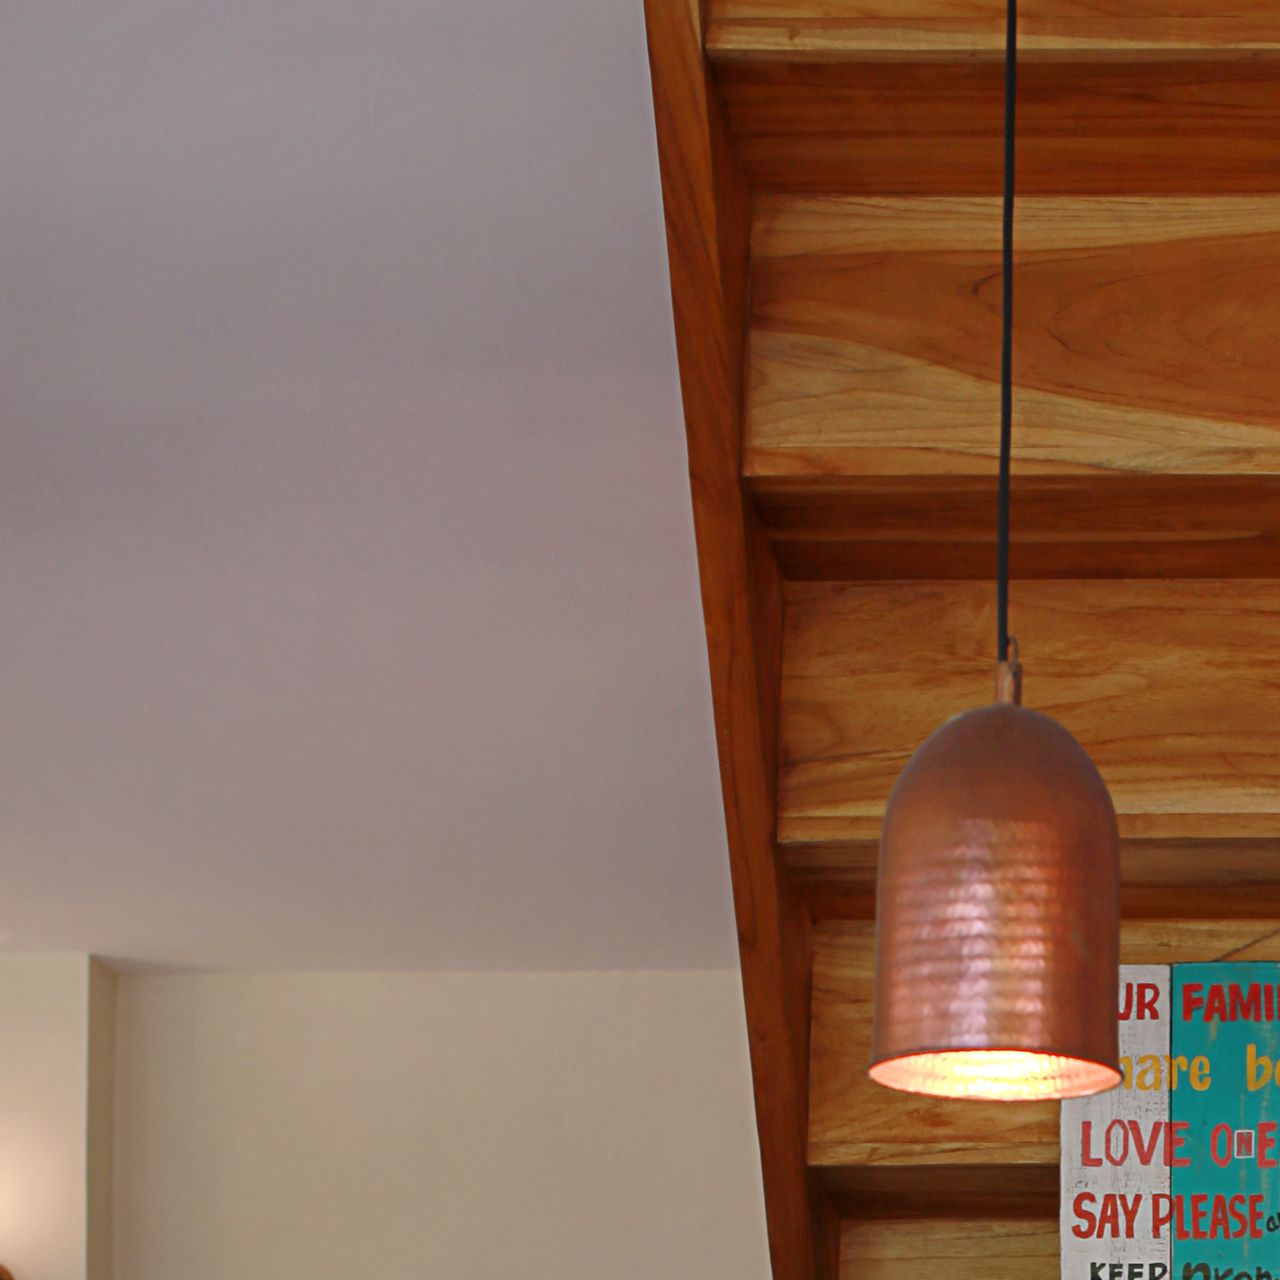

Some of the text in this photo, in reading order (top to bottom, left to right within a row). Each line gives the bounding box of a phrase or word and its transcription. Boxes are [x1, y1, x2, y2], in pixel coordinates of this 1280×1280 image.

[1117, 982, 1161, 1021] UR
[1119, 1053, 1212, 1092] are
[1080, 1118, 1192, 1168] LOVE
[1209, 1121, 1278, 1169] ONE
[1071, 1192, 1143, 1240] SAY
[1151, 1192, 1265, 1241] PLEASE
